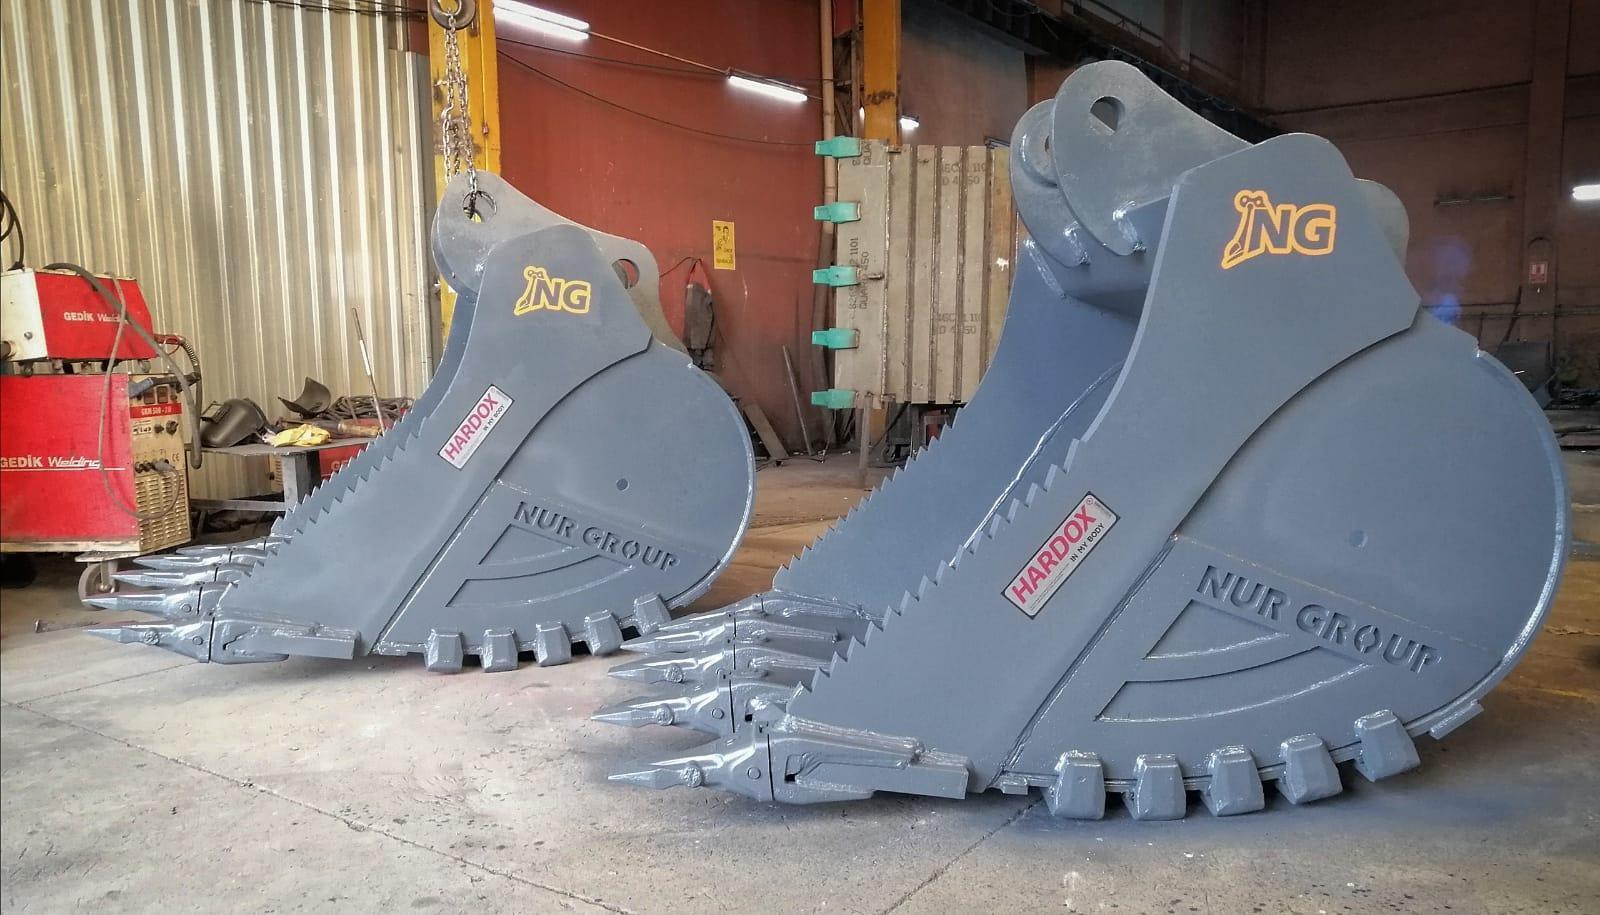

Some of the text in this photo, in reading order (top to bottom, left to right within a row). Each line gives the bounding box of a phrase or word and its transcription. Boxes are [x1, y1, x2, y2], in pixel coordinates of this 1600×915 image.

[0, 454, 43, 468] GEDİK
[444, 392, 499, 460] HARDOX
[513, 500, 680, 573] NUR GROUP
[1011, 503, 1097, 605] HARDOX
[1069, 552, 1079, 562] IN
[1077, 541, 1089, 554] MY
[1086, 522, 1105, 543] BODY
[1196, 564, 1443, 675] NUR GROUP
